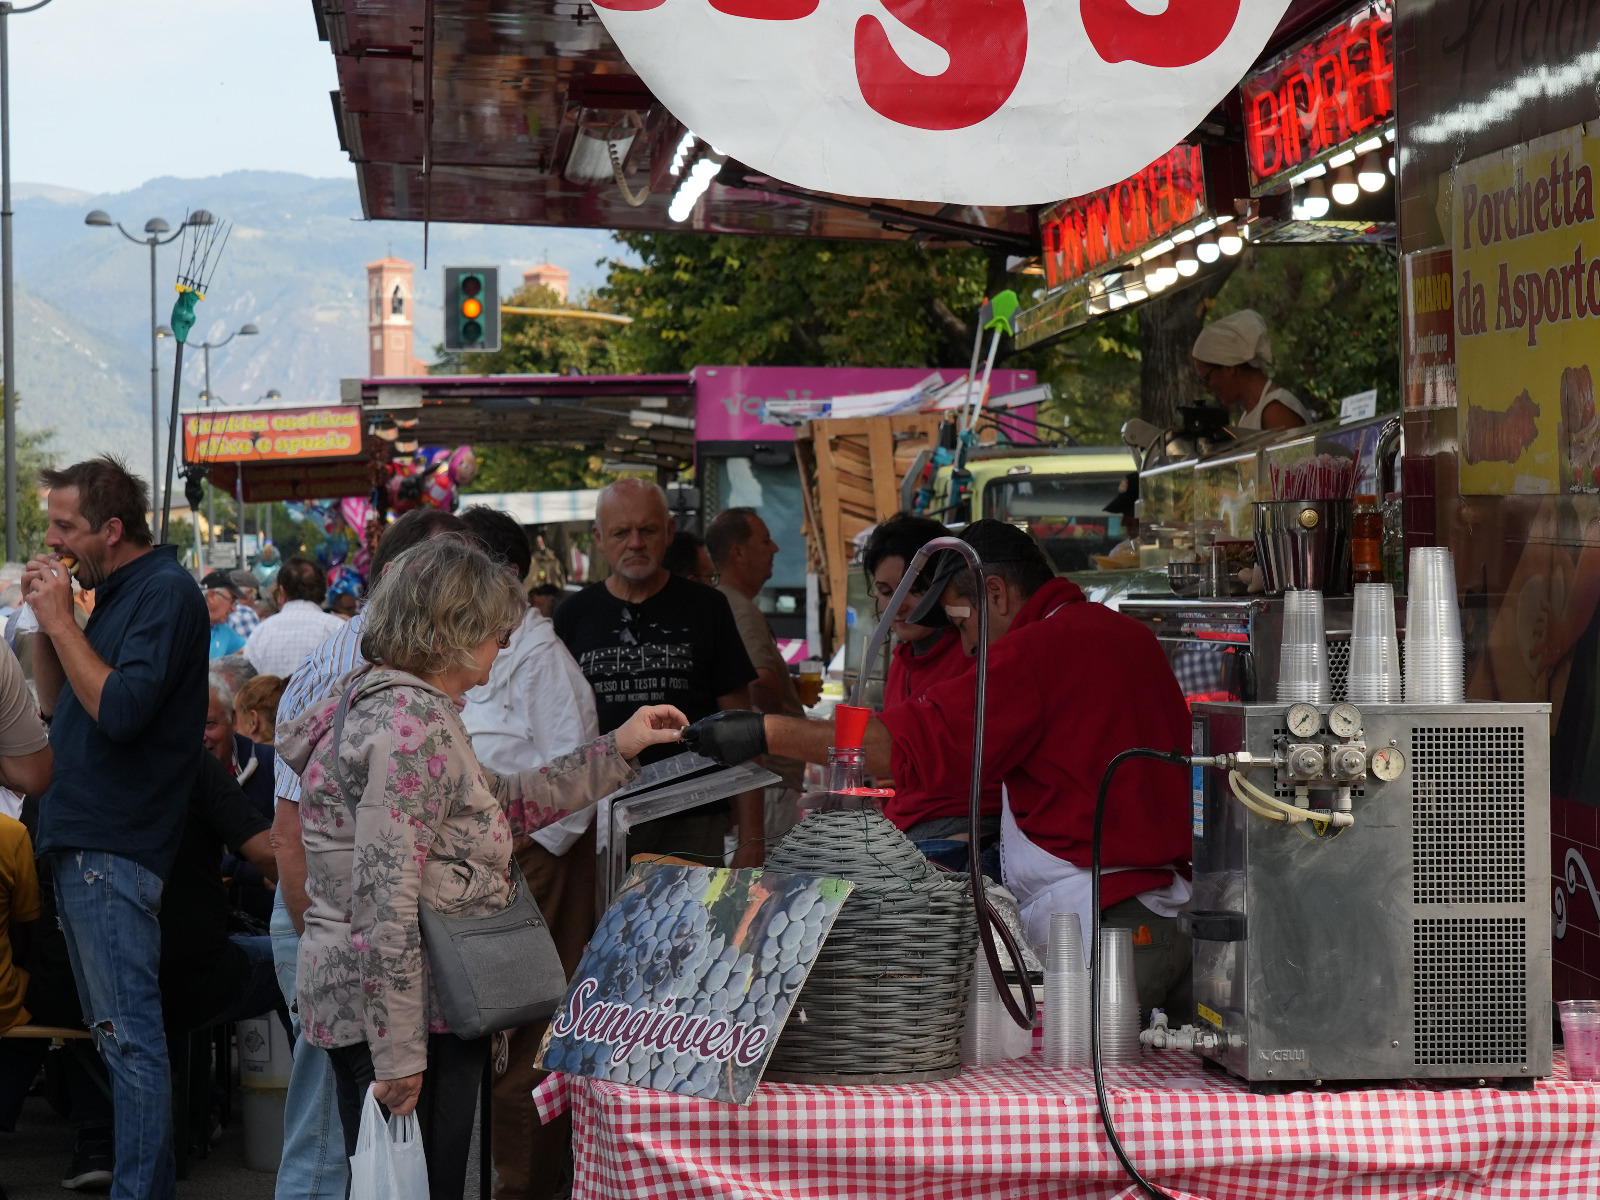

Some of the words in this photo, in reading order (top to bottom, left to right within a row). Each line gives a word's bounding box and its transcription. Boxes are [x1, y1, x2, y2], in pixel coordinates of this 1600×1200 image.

[1462, 151, 1594, 250] Porchetta
[1407, 272, 1451, 315] UCIANO
[1457, 270, 1487, 335] da
[1495, 241, 1600, 346] Asporto
[1416, 329, 1448, 359] boutique
[271, 409, 358, 431] esotica
[197, 434, 253, 456] olive
[256, 437, 272, 453] e
[620, 679, 630, 690] LA
[634, 677, 658, 691] TESTA
[661, 677, 667, 688] A
[553, 977, 769, 1067] Sangiovese
[1273, 1050, 1305, 1061] CELLI
